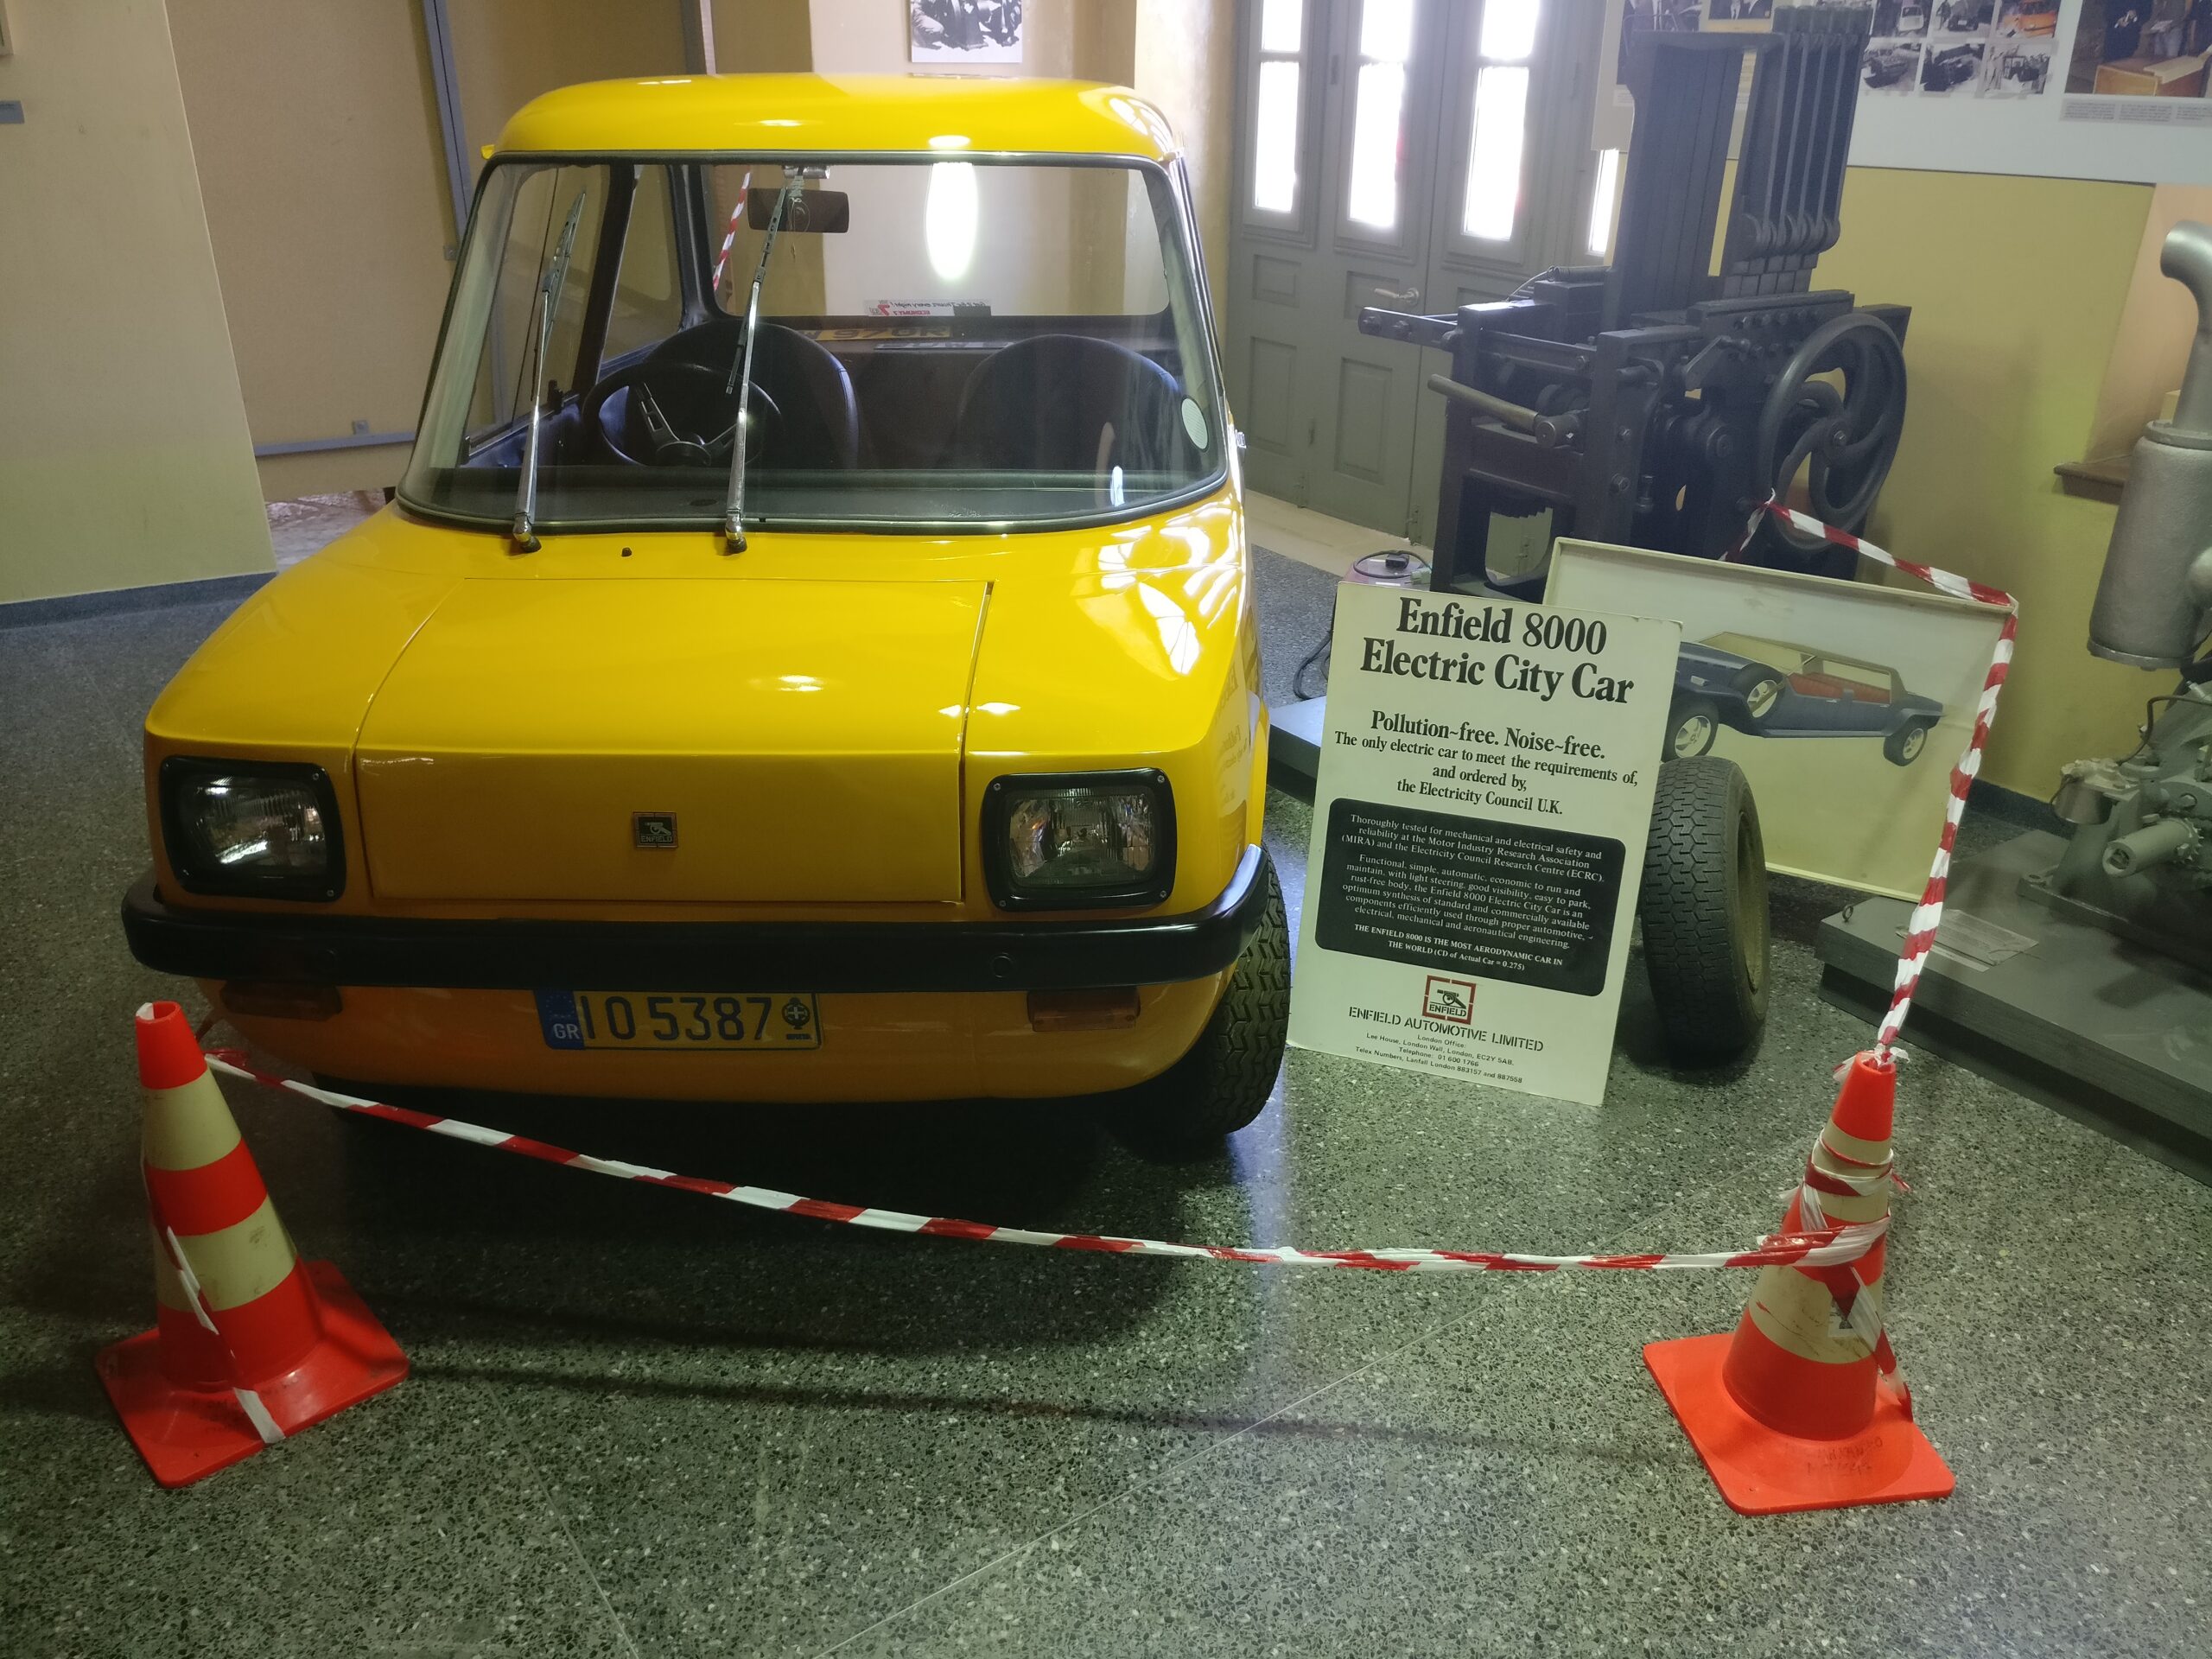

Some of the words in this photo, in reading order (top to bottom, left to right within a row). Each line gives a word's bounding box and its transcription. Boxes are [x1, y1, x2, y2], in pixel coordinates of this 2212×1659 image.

[1395, 596, 1514, 644] Enfield
[1522, 612, 1607, 656] 8000
[1359, 637, 1486, 686] Electric
[1494, 653, 1565, 702] City
[1571, 662, 1635, 704] Car
[1334, 730, 1358, 747] The
[1361, 735, 1389, 753] only
[1389, 738, 1435, 756] electric
[1437, 747, 1459, 760] car
[1461, 748, 1473, 761] to
[1475, 753, 1507, 766] meet
[1510, 753, 1531, 769] the
[1533, 760, 1618, 782] requirements
[1622, 770, 1638, 787] of,
[1396, 778, 1416, 793] the
[1418, 780, 1483, 805] Electricity
[1485, 791, 1534, 811] Council
[1537, 798, 1563, 815] U.K.
[1432, 765, 1457, 779] and
[1459, 768, 1508, 786] ordered
[1510, 773, 1527, 792] by,
[1341, 834, 1375, 847] (MIRA)
[1376, 841, 1393, 849] and
[1395, 842, 1408, 852] the
[1411, 844, 1456, 861] Electricity
[1457, 851, 1491, 865] Council
[1493, 856, 1533, 871] Research
[1534, 863, 1565, 876] Centre
[1351, 814, 1400, 830] Thoroughly
[1402, 823, 1427, 833] tested
[1429, 826, 1443, 836] for
[1445, 830, 1493, 843] mechanical
[1494, 837, 1512, 846] and
[1513, 839, 1554, 853] electrical
[1555, 846, 1584, 858] safety
[1585, 851, 1602, 860] and
[1358, 827, 1399, 841] reliability
[1412, 834, 1426, 843] the
[1428, 836, 1456, 849] Motor
[1457, 841, 1495, 855] Industry
[1497, 847, 1536, 861] Research
[1538, 854, 1590, 869] Association
[1351, 874, 1386, 887] rust-free
[1414, 883, 1428, 893] the
[1430, 886, 1462, 899] Enfield
[1463, 891, 1487, 902] 8000
[1488, 895, 1522, 908] Electric
[1523, 901, 1543, 913] City
[1544, 905, 1561, 915] Car
[1388, 869, 1407, 880] with
[1408, 872, 1428, 883] light
[1467, 883, 1491, 893] good
[1534, 894, 1554, 905] easy
[1556, 896, 1567, 905] to
[1490, 876, 1532, 889] economic
[1534, 882, 1544, 891] to
[1546, 885, 1562, 893] run
[1563, 888, 1581, 897] and
[1342, 884, 1381, 896] optimum
[1382, 890, 1421, 902] synthesis
[1433, 899, 1471, 911] standard
[1471, 905, 1489, 913] and
[1491, 908, 1550, 925] commercially
[1551, 918, 1590, 931] available
[1345, 895, 1396, 909] components
[1397, 902, 1441, 918] efficiently
[1443, 911, 1463, 920] used
[1465, 912, 1499, 926] through
[1500, 920, 1531, 931] proper
[1396, 913, 1444, 927] mechanical
[1445, 921, 1462, 930] and
[1463, 925, 1516, 939] aeronautical
[1354, 923, 1370, 932] THE
[1370, 926, 1405, 938] ENFIELD
[1405, 932, 1423, 942] 8000
[1433, 937, 1450, 947] THE
[1450, 940, 1473, 950] MOST
[1473, 944, 1534, 961] AERODYNAMIC
[1534, 955, 1552, 964] CAR
[1553, 957, 1563, 966] IN
[1388, 940, 1404, 950] THE
[1405, 943, 1433, 955] WORLD
[1433, 949, 1449, 957] (CD
[1459, 953, 1481, 963] Actual
[1482, 957, 1495, 965] Car
[1502, 960, 1525, 971] 0.275)
[646, 996, 772, 1041] 5387
[1349, 1006, 1402, 1026] ENFIELD
[1403, 1017, 1488, 1042] AUTOMOTIVE
[1491, 1033, 1544, 1052] LIMITED
[1428, 1004, 1467, 1017] ENFIELD
[552, 1023, 581, 1040] GR
[1366, 1032, 1378, 1040] Lee
[1379, 1034, 1402, 1046] House,
[1402, 1039, 1428, 1050] London
[1417, 1033, 1443, 1045] London
[1355, 1046, 1372, 1055] Telex
[1373, 1049, 1404, 1062] Numbers,
[1430, 1060, 1456, 1071] London
